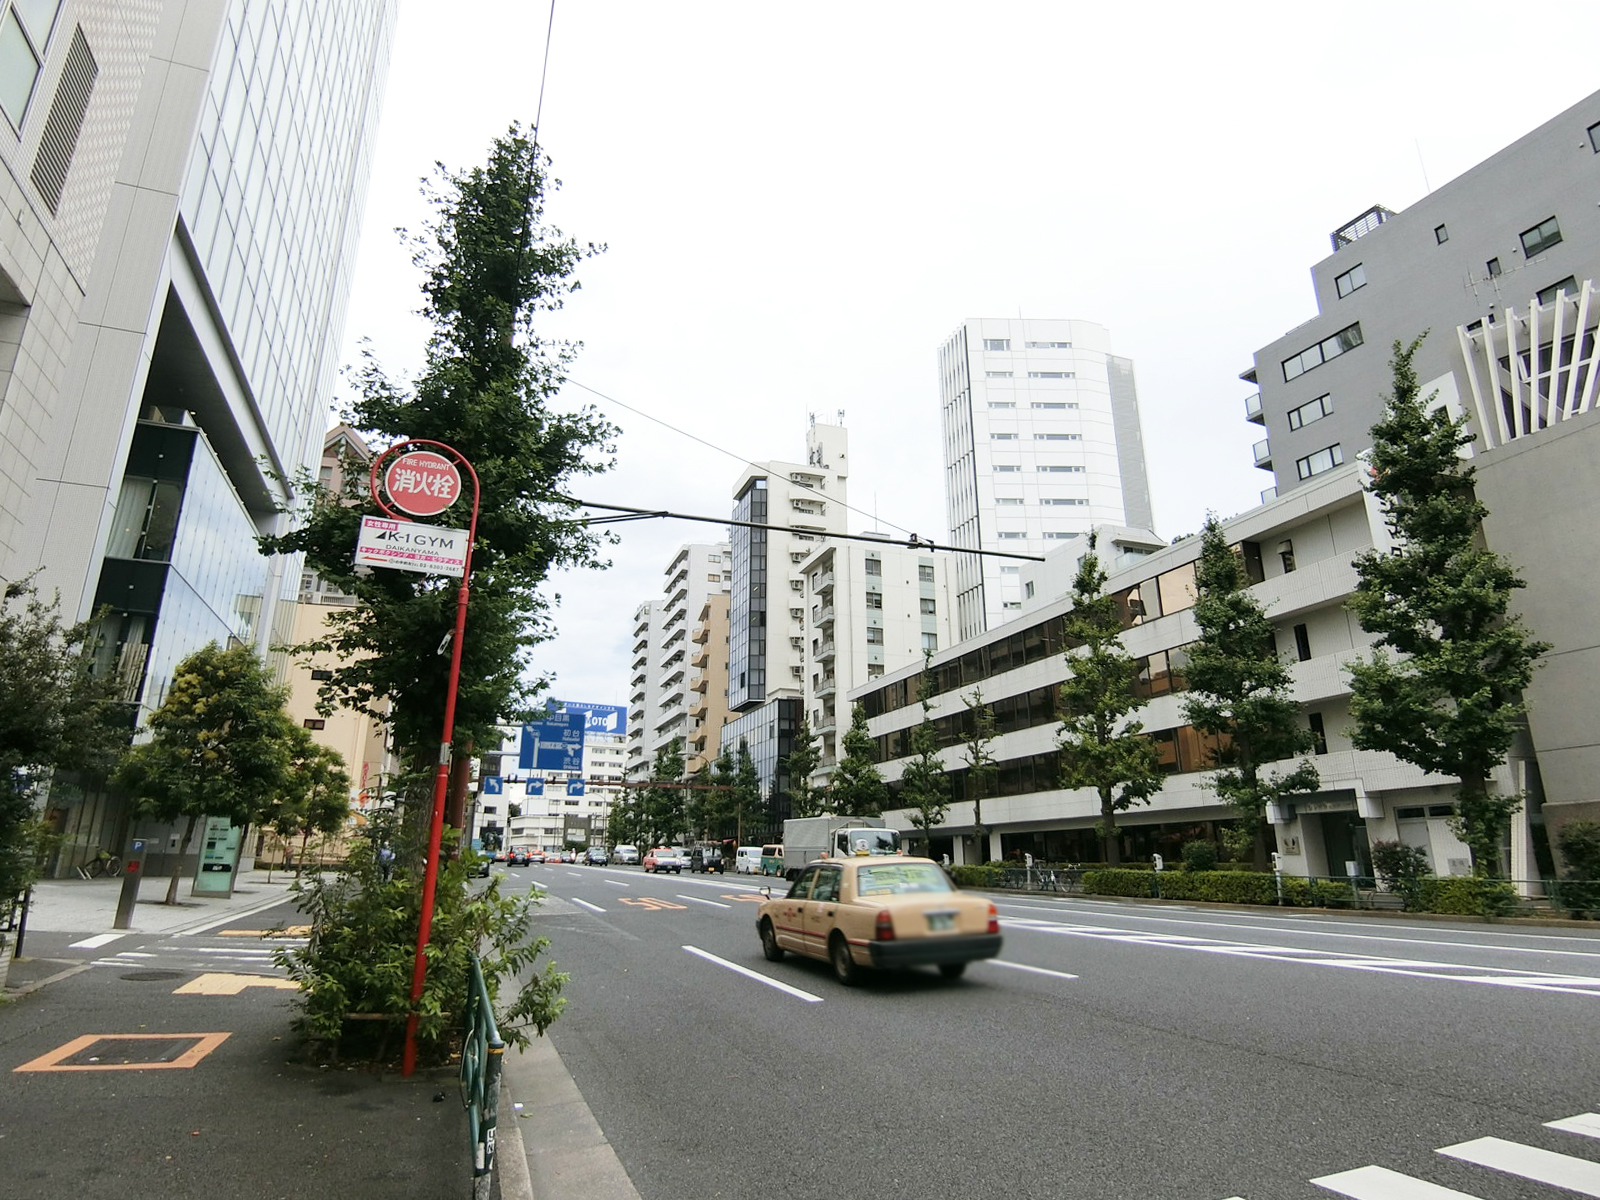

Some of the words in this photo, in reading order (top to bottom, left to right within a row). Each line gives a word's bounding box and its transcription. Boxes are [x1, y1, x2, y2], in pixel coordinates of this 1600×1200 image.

[402, 457, 418, 466] FIRE
[419, 460, 452, 471] HYDRANT
[392, 467, 455, 499] 消火栓
[366, 520, 397, 531] 女性専用
[387, 531, 410, 544] K-1
[413, 534, 454, 550] GYM
[385, 544, 440, 556] DAIKANYAMA
[134, 842, 142, 850] P
